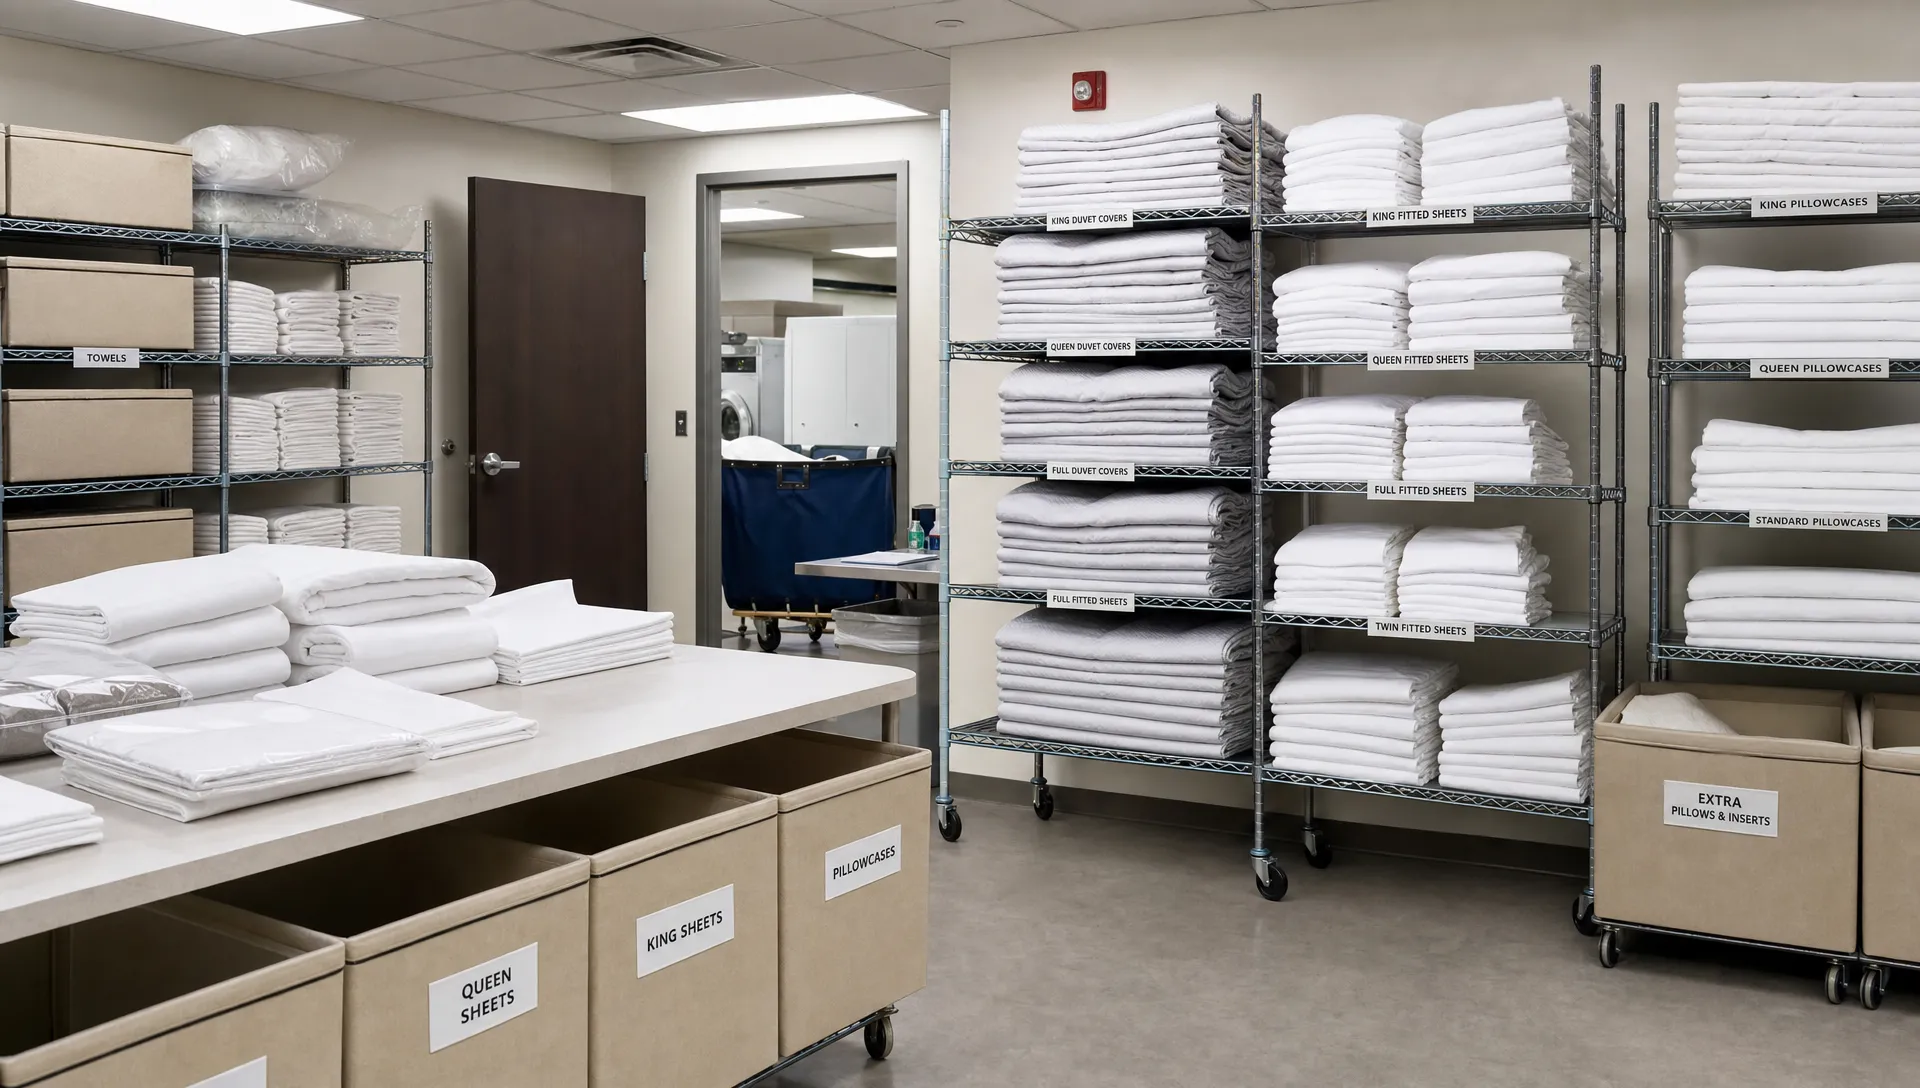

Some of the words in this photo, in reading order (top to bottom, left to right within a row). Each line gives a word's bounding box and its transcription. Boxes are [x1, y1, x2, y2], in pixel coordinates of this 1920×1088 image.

[1760, 200, 1786, 209] KING
[1791, 198, 1868, 208] PILLOWCASES
[1052, 216, 1069, 225] KING
[1072, 215, 1096, 224] DUVET
[1098, 214, 1127, 223] COVERS
[1373, 212, 1395, 221] KING
[1398, 210, 1429, 220] FITTED
[1432, 209, 1467, 218] SHEETS
[1051, 343, 1075, 352] QUEEN
[1077, 343, 1101, 351] DUVET
[1103, 342, 1131, 351] COVERS
[87, 354, 126, 363] TOWELS
[1373, 356, 1402, 365] QUEEN
[1405, 355, 1434, 364] FITTED
[1436, 355, 1468, 364] SHEETS
[1759, 364, 1799, 373] QUEEN
[1803, 364, 1882, 373] PILLOWCASES
[1052, 467, 1069, 475] FULL
[1072, 467, 1097, 476] DUVET
[1098, 468, 1128, 476] COVERS
[1375, 485, 1396, 494] FULL
[1399, 486, 1430, 495] FITTED
[1433, 487, 1467, 496] SHEETS
[1756, 516, 1808, 525] STANDARD
[1813, 518, 1880, 527] PILLOWCASES
[1053, 595, 1070, 604] FULL
[1072, 596, 1097, 605] FITTED
[1099, 597, 1128, 606] SHEETS
[1376, 622, 1399, 631] TWIN
[1402, 624, 1431, 633] FITTED
[1434, 626, 1466, 635] SHEETS
[1699, 793, 1742, 808] EXTRA
[1672, 806, 1715, 820] PILLOWS
[1718, 811, 1725, 821] &
[1729, 813, 1770, 826] INSERTS
[833, 845, 895, 880] PILLOWCASES
[648, 929, 676, 952] KING
[681, 911, 722, 938] SHEETS
[462, 967, 512, 999] QUEEN
[460, 989, 515, 1024] SHEETS
